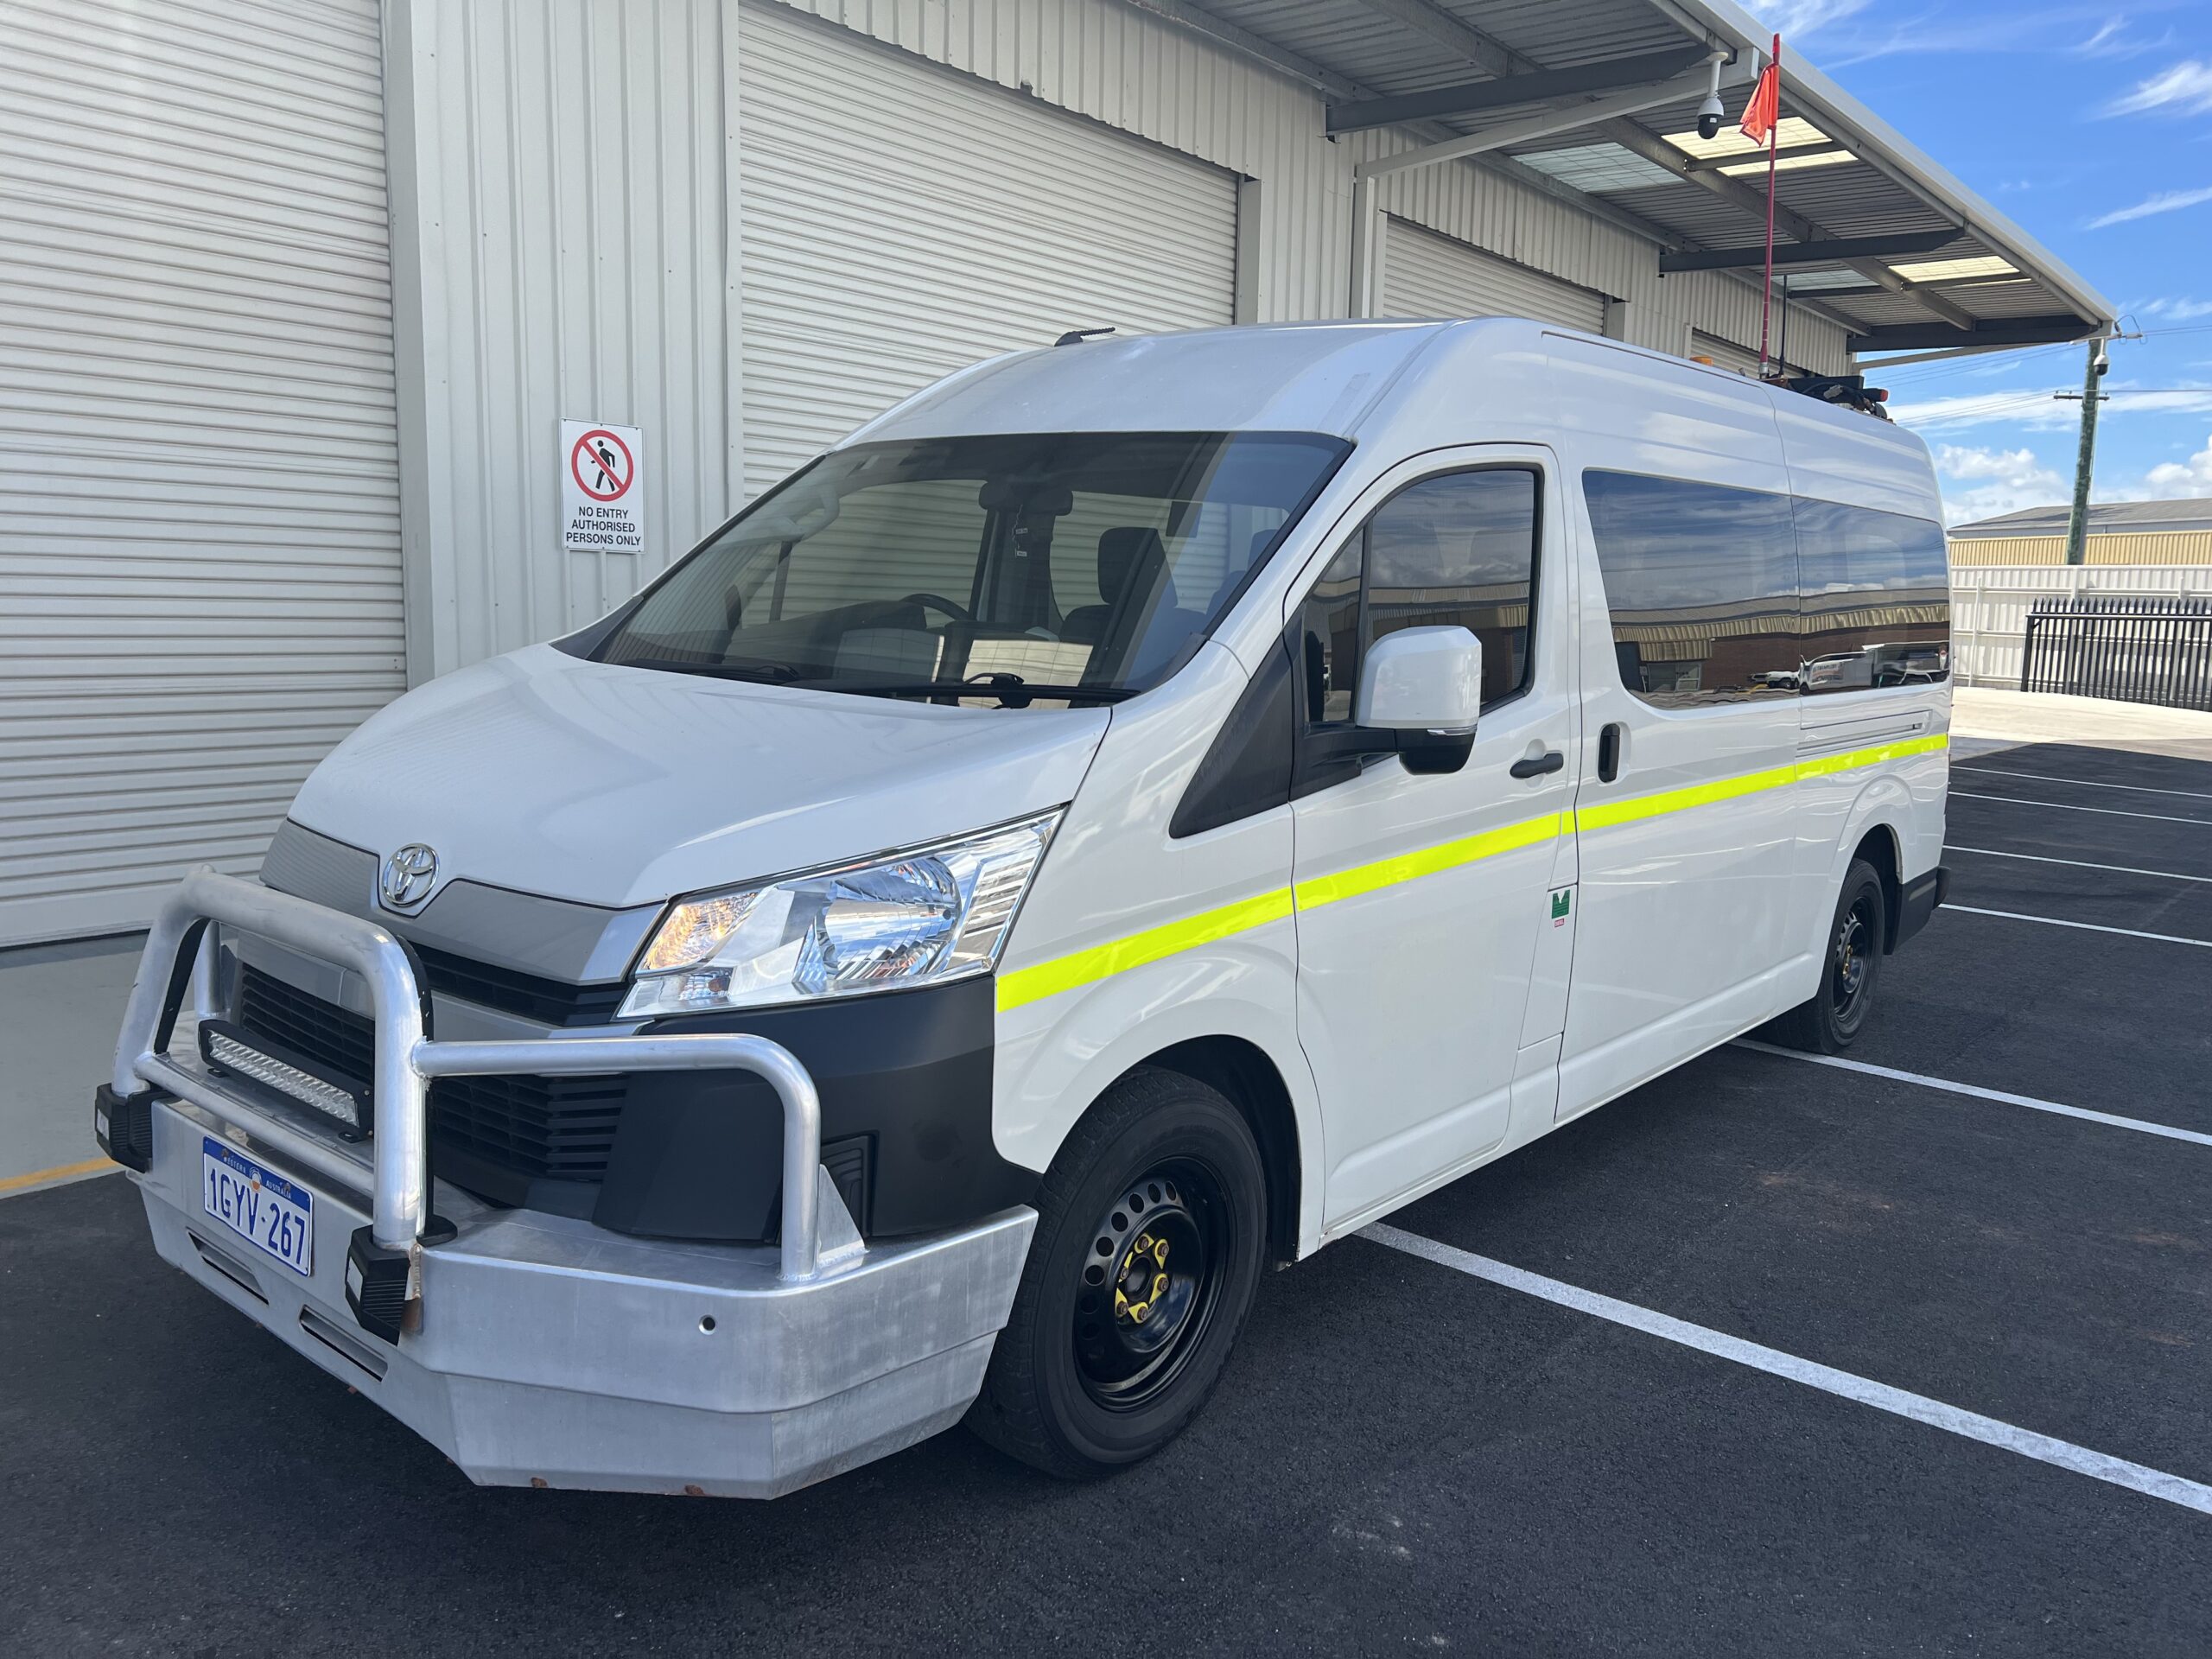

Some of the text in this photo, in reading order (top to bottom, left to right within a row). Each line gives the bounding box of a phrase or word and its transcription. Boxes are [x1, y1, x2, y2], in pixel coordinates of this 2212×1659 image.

[579, 506, 629, 519] NO ENTRY
[571, 519, 636, 532] AUTHORISED
[566, 532, 641, 546] PERSONS ONLY
[265, 1179, 291, 1199] AUSTRALIA
